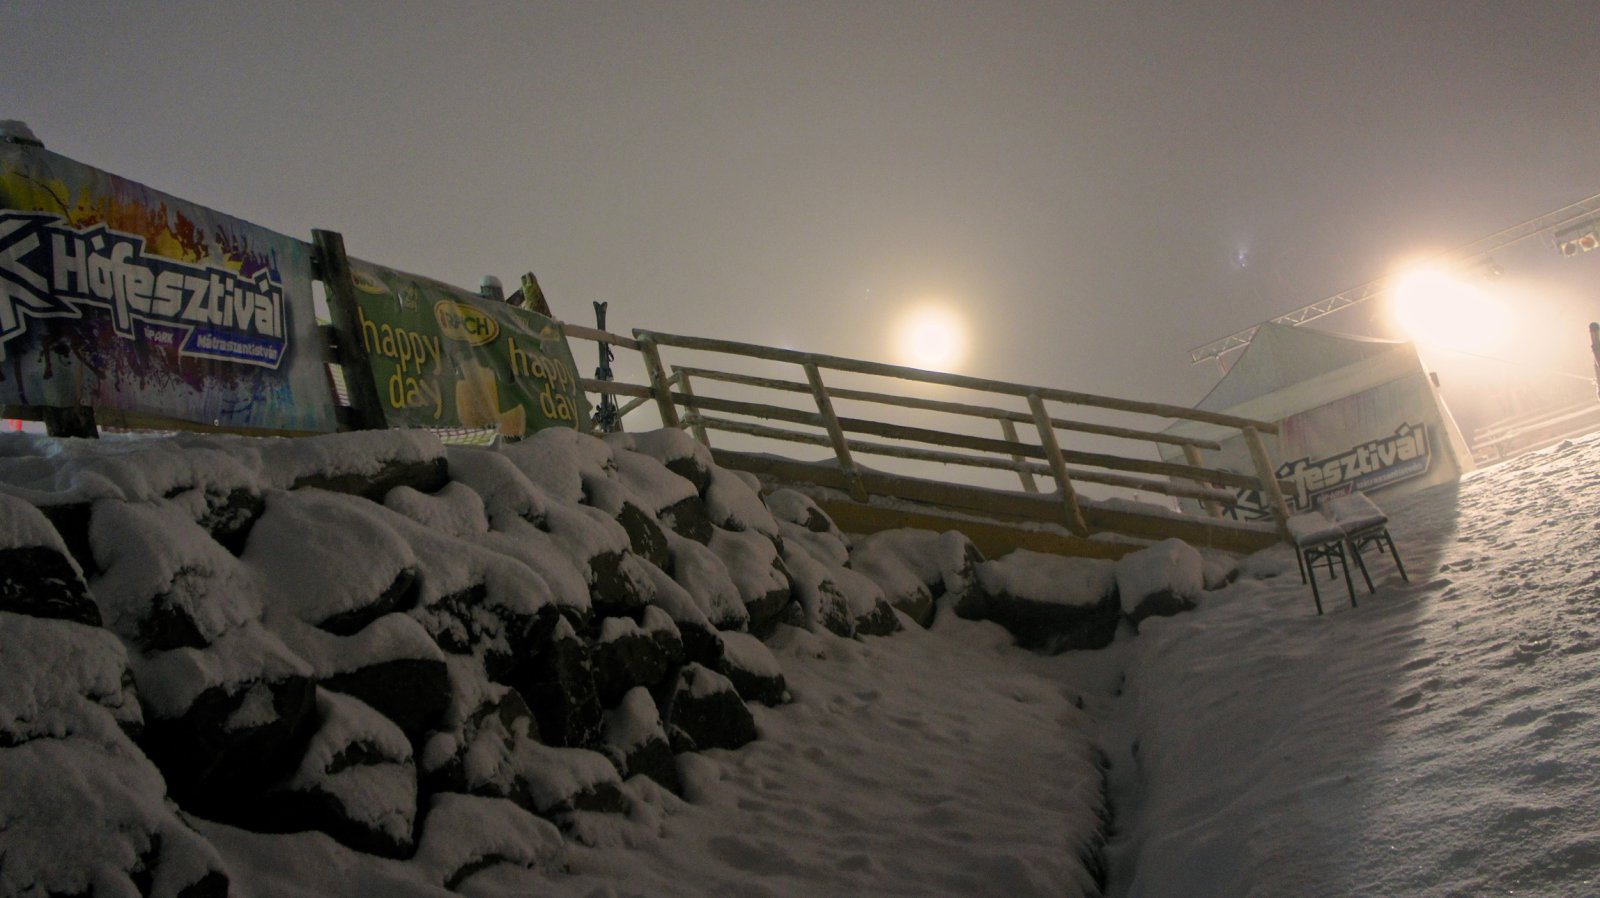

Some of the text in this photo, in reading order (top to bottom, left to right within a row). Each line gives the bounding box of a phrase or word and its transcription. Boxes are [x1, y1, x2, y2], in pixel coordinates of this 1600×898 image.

[51, 232, 282, 338] Hófesztivál
[357, 306, 442, 376] happy
[507, 335, 577, 396] happy
[388, 364, 443, 420] day
[539, 382, 579, 432] day
